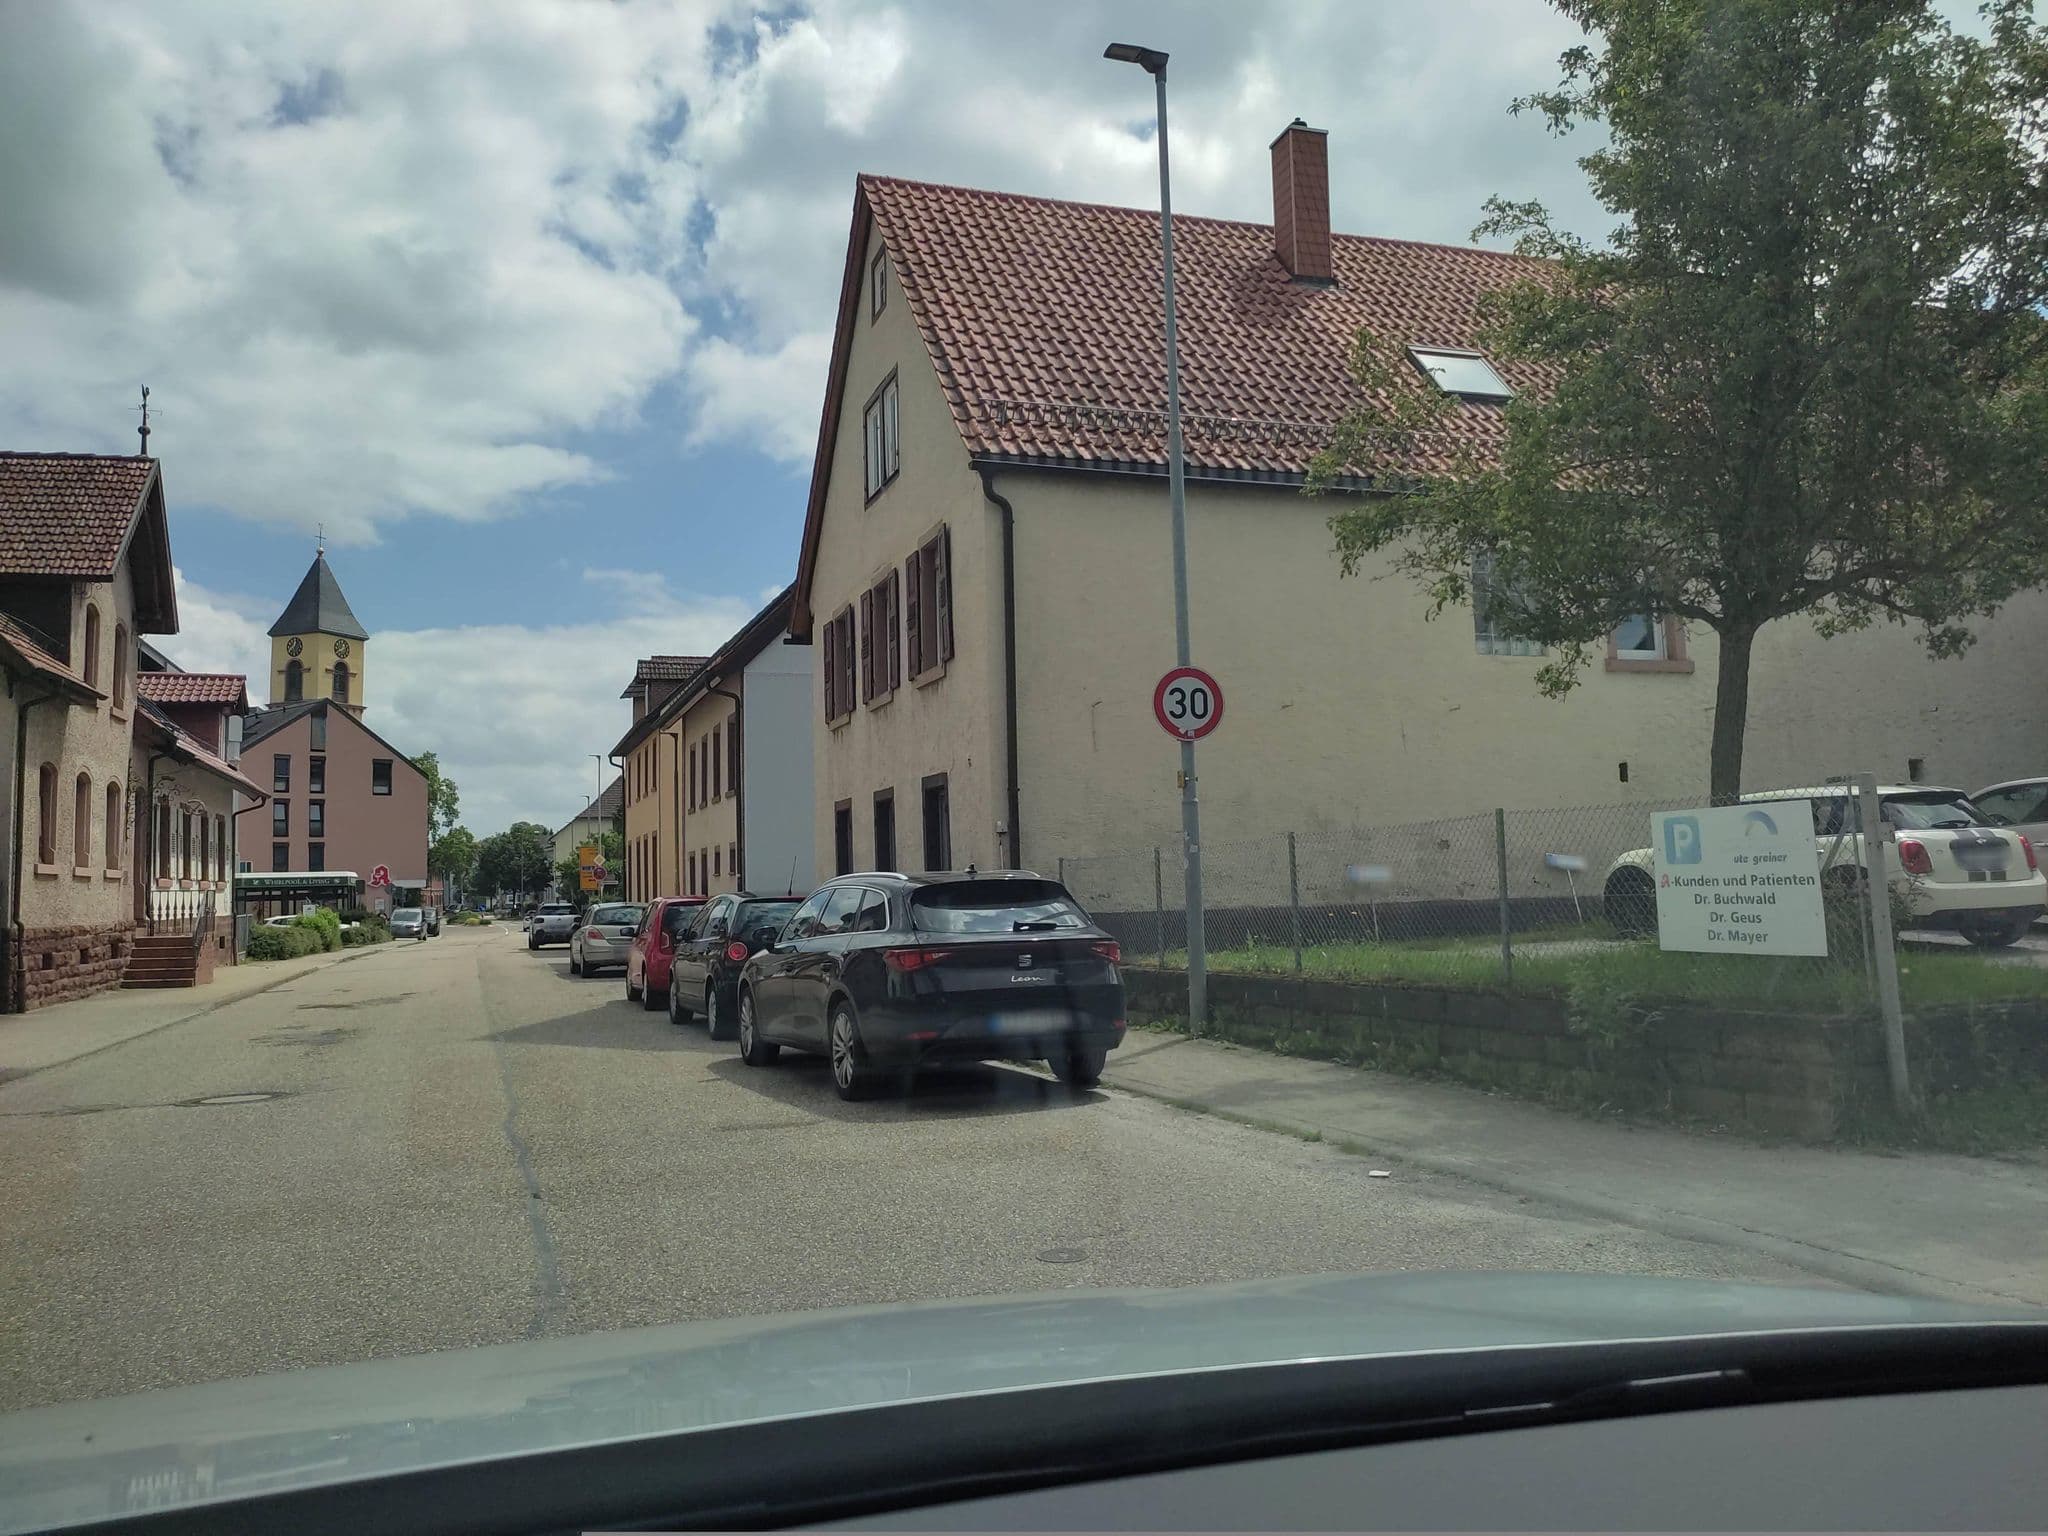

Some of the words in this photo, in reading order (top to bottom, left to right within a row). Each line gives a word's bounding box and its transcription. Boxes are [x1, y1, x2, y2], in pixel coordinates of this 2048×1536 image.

[1169, 687, 1208, 719] 30
[1672, 823, 1693, 860] P
[1733, 853, 1748, 864] ute
[1753, 851, 1788, 866] greiner
[1723, 874, 1747, 887] und
[1750, 873, 1815, 886] Patienten
[1694, 893, 1711, 905] Dr.
[1714, 892, 1776, 905] Buchwald
[1710, 911, 1727, 923] Dr.
[1730, 911, 1762, 924] Geus
[1707, 929, 1725, 941] Dr.
[1728, 930, 1768, 944] Mayer
[1011, 975, 1046, 983] Leon
